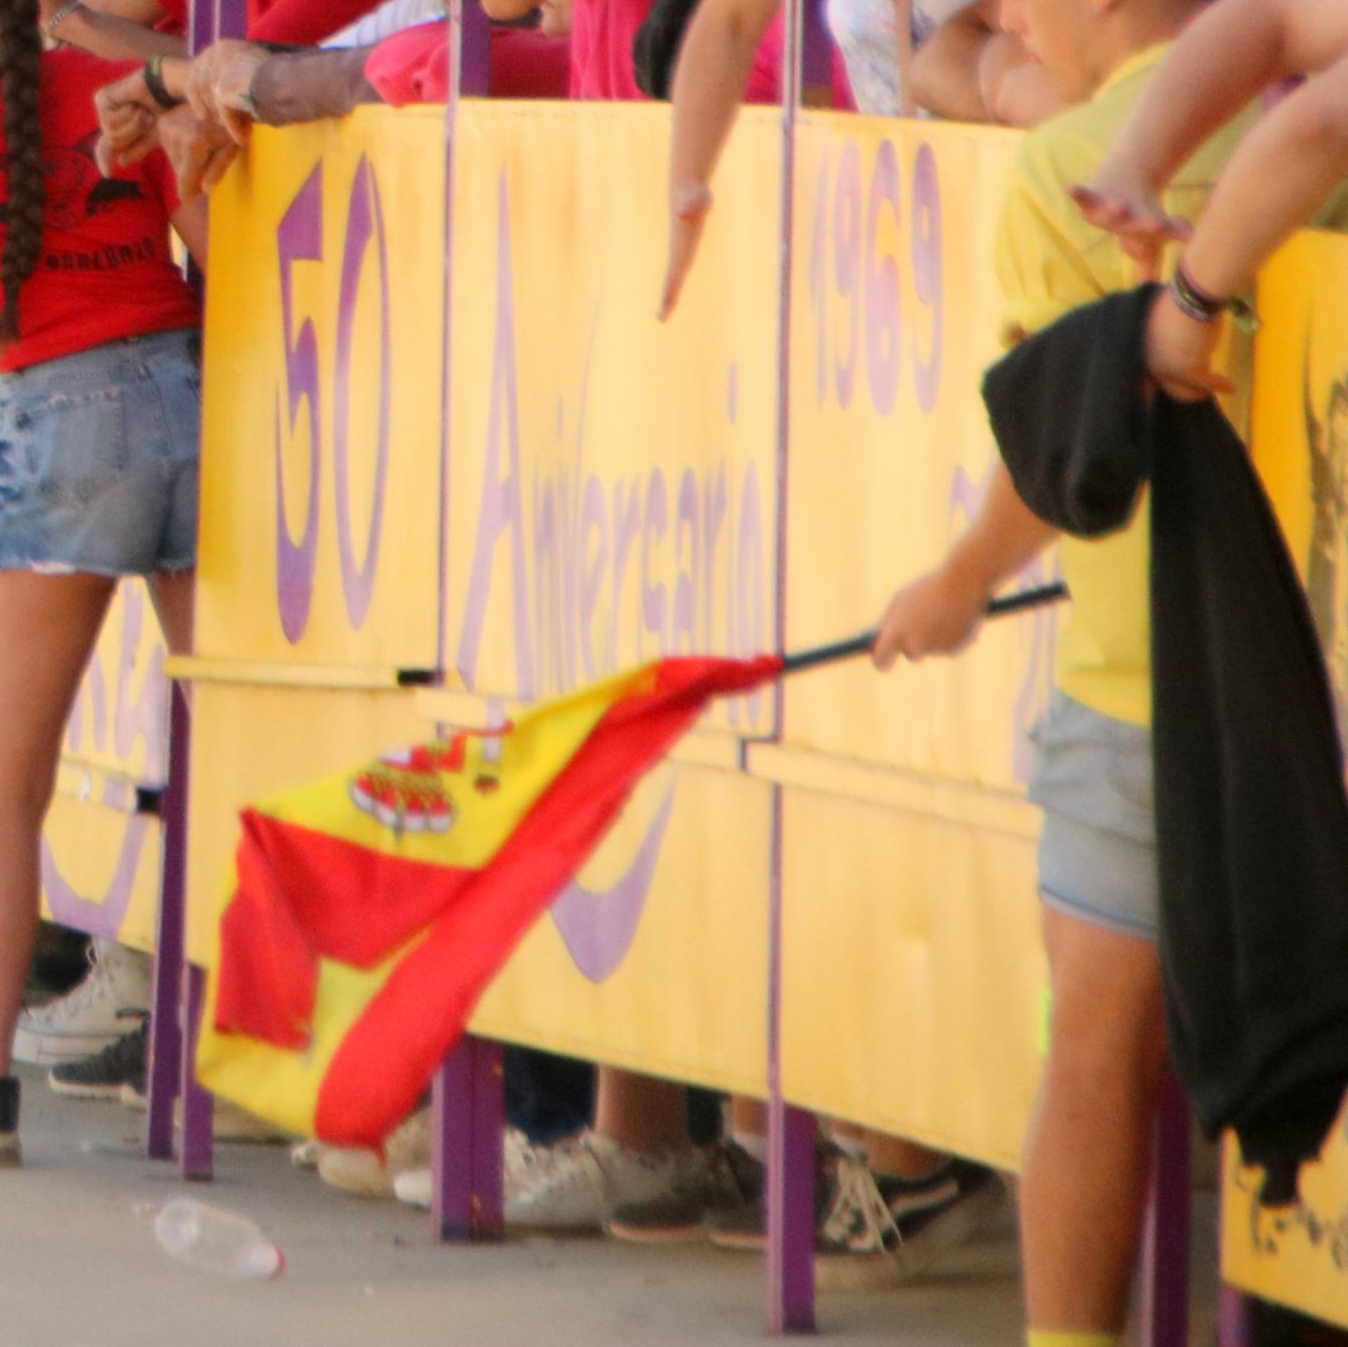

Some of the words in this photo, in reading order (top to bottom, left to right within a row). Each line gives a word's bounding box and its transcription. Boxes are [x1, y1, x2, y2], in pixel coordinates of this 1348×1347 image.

[275, 150, 392, 647] 50
[455, 156, 763, 730] Aniversario
[808, 136, 944, 417] 1969
